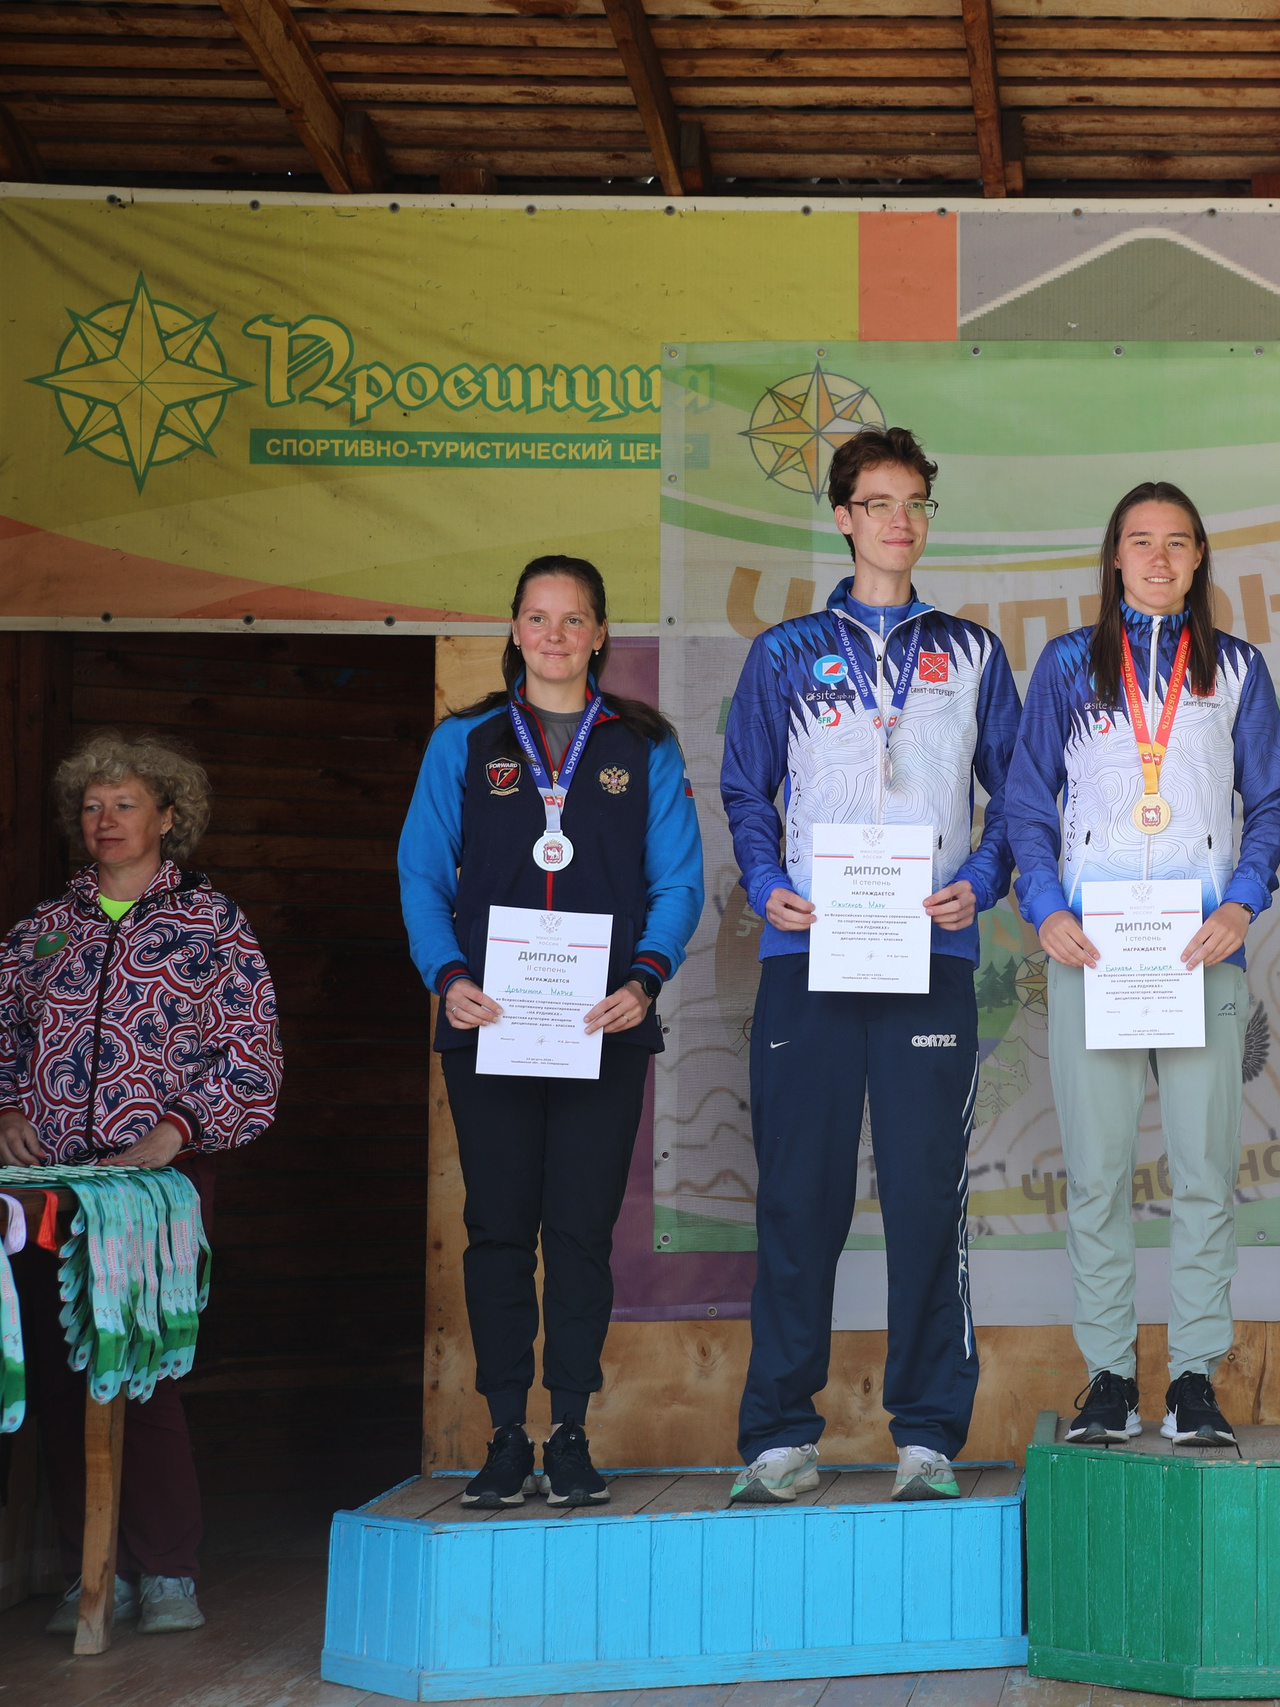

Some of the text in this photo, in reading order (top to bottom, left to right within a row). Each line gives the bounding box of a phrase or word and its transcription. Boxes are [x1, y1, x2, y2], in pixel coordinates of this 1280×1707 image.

[265, 437, 612, 463] СПОРТИВНО-ТУРИСТИЧЕСКИЙ
[1161, 641, 1188, 730] ЧЕЛЯБИНСКАЯ ОБЛАСТЬ
[564, 739, 583, 776] ОБЛАСТЬ
[844, 866, 901, 876] ДИПЛОМ
[1115, 922, 1171, 932] ДИПЛОМ
[518, 951, 577, 963] ДИПЛОМ
